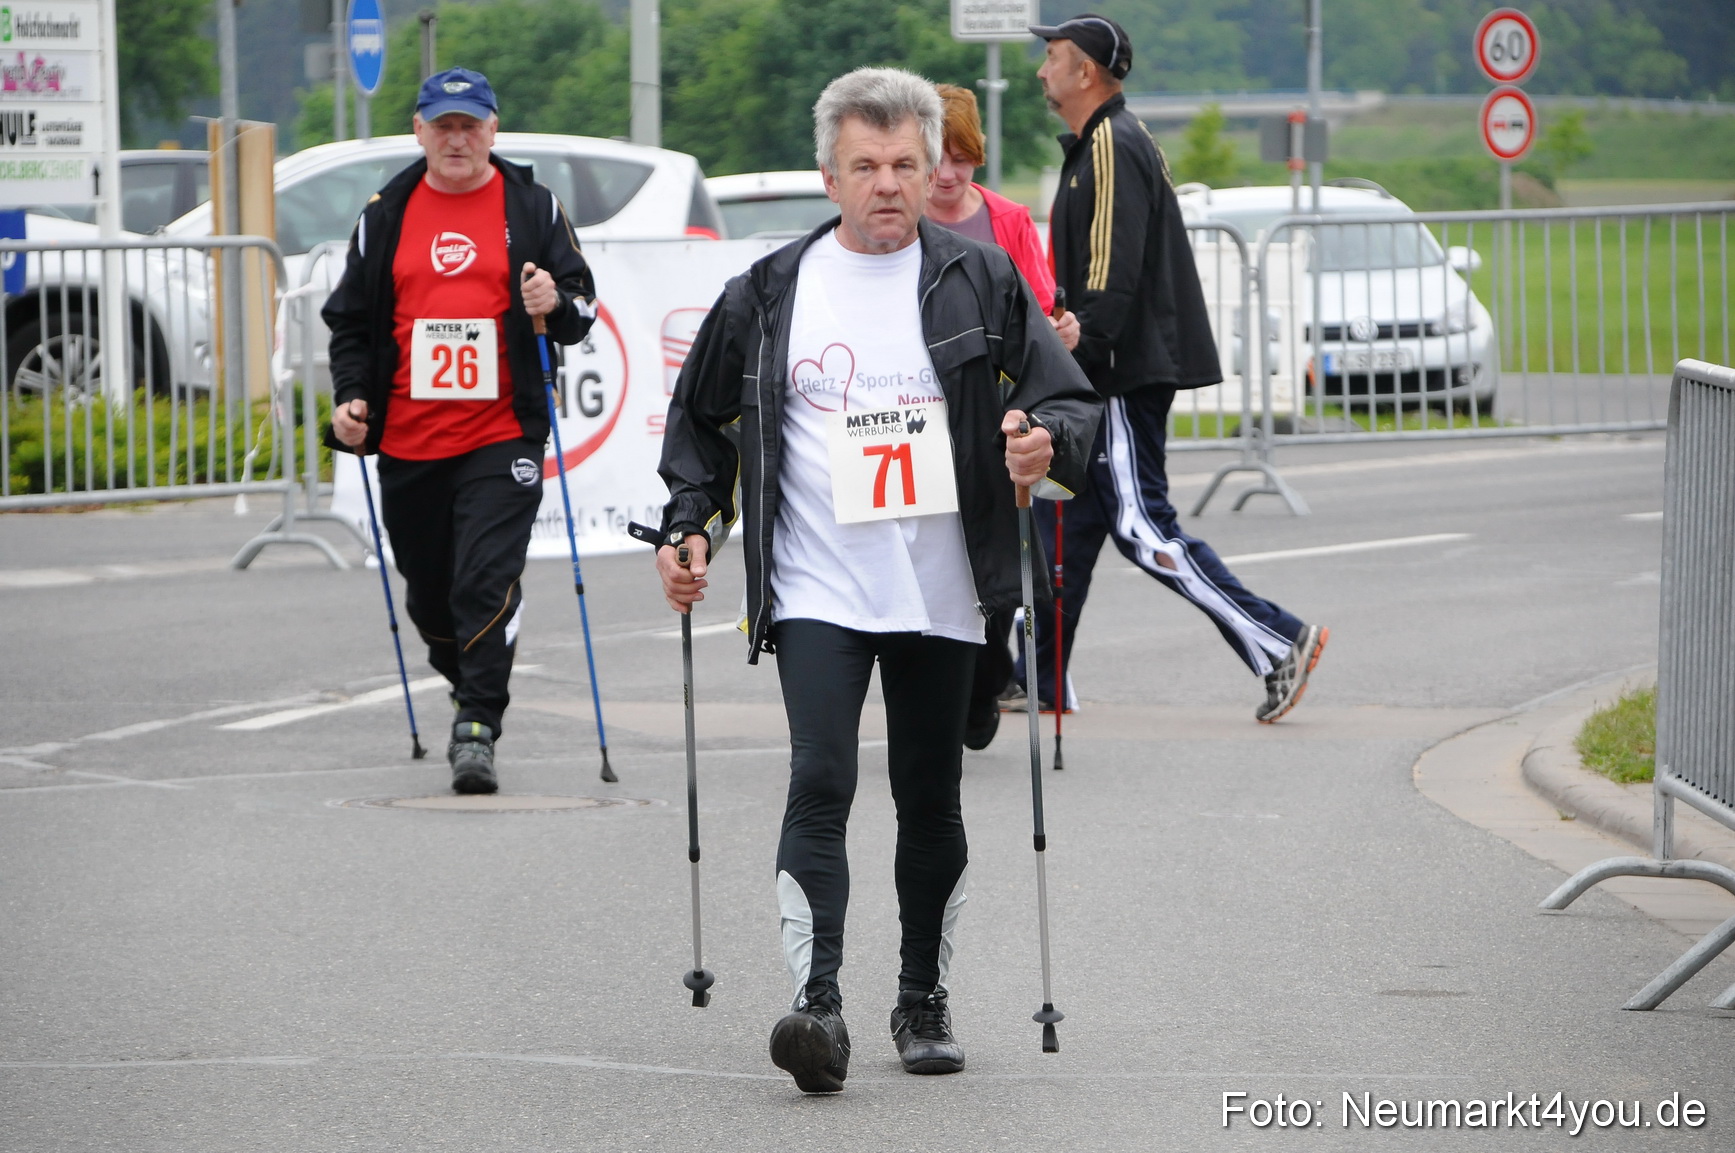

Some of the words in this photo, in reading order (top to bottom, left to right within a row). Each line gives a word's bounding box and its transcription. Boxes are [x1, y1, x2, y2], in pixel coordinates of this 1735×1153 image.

[1490, 30, 1525, 62] 60
[425, 323, 462, 332] MEYER
[425, 332, 463, 340] WERBUNG
[431, 344, 478, 390] 26
[801, 377, 836, 394] Herz
[856, 372, 903, 391] Sport
[846, 411, 902, 428] MEYER
[847, 424, 903, 437] WERBUNG
[863, 443, 916, 508] 71
